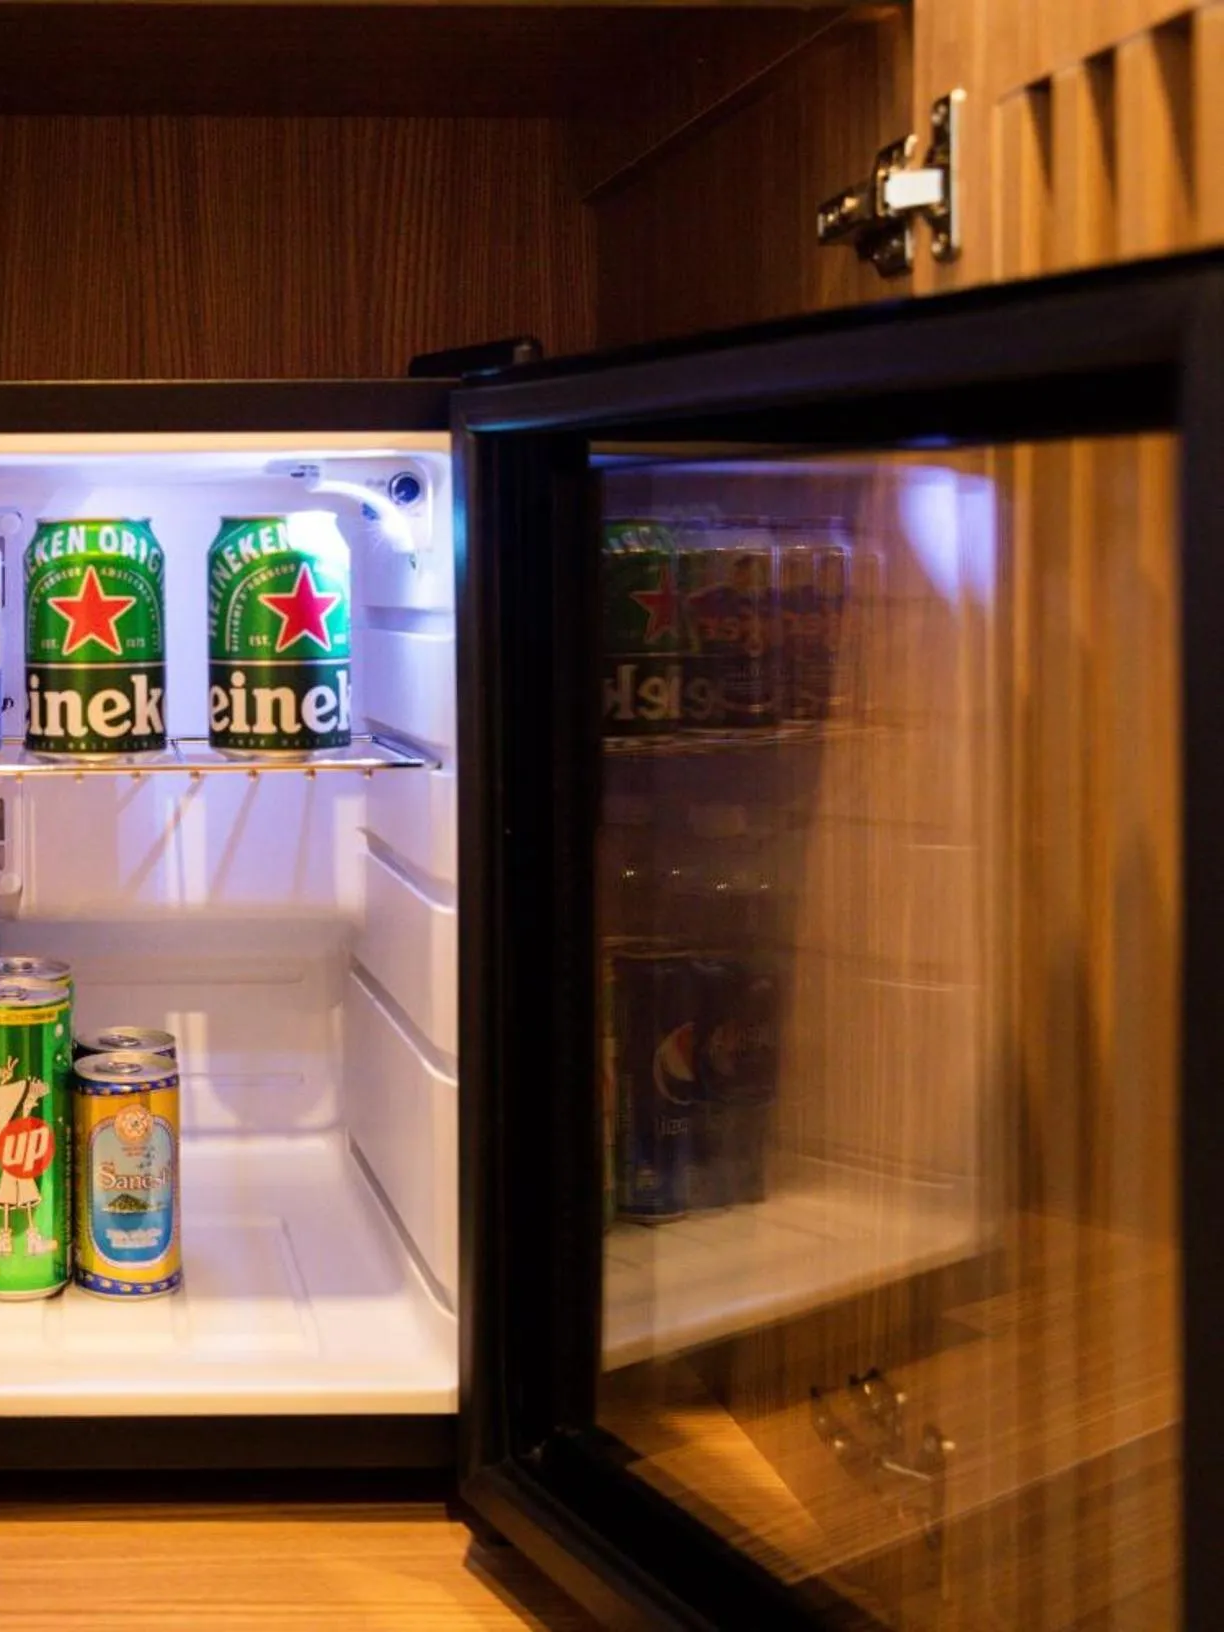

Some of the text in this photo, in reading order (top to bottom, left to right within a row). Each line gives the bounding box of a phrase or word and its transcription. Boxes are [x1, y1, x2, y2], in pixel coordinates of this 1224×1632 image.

[25, 525, 164, 584] EKEN ORIG
[27, 674, 165, 738] inek
